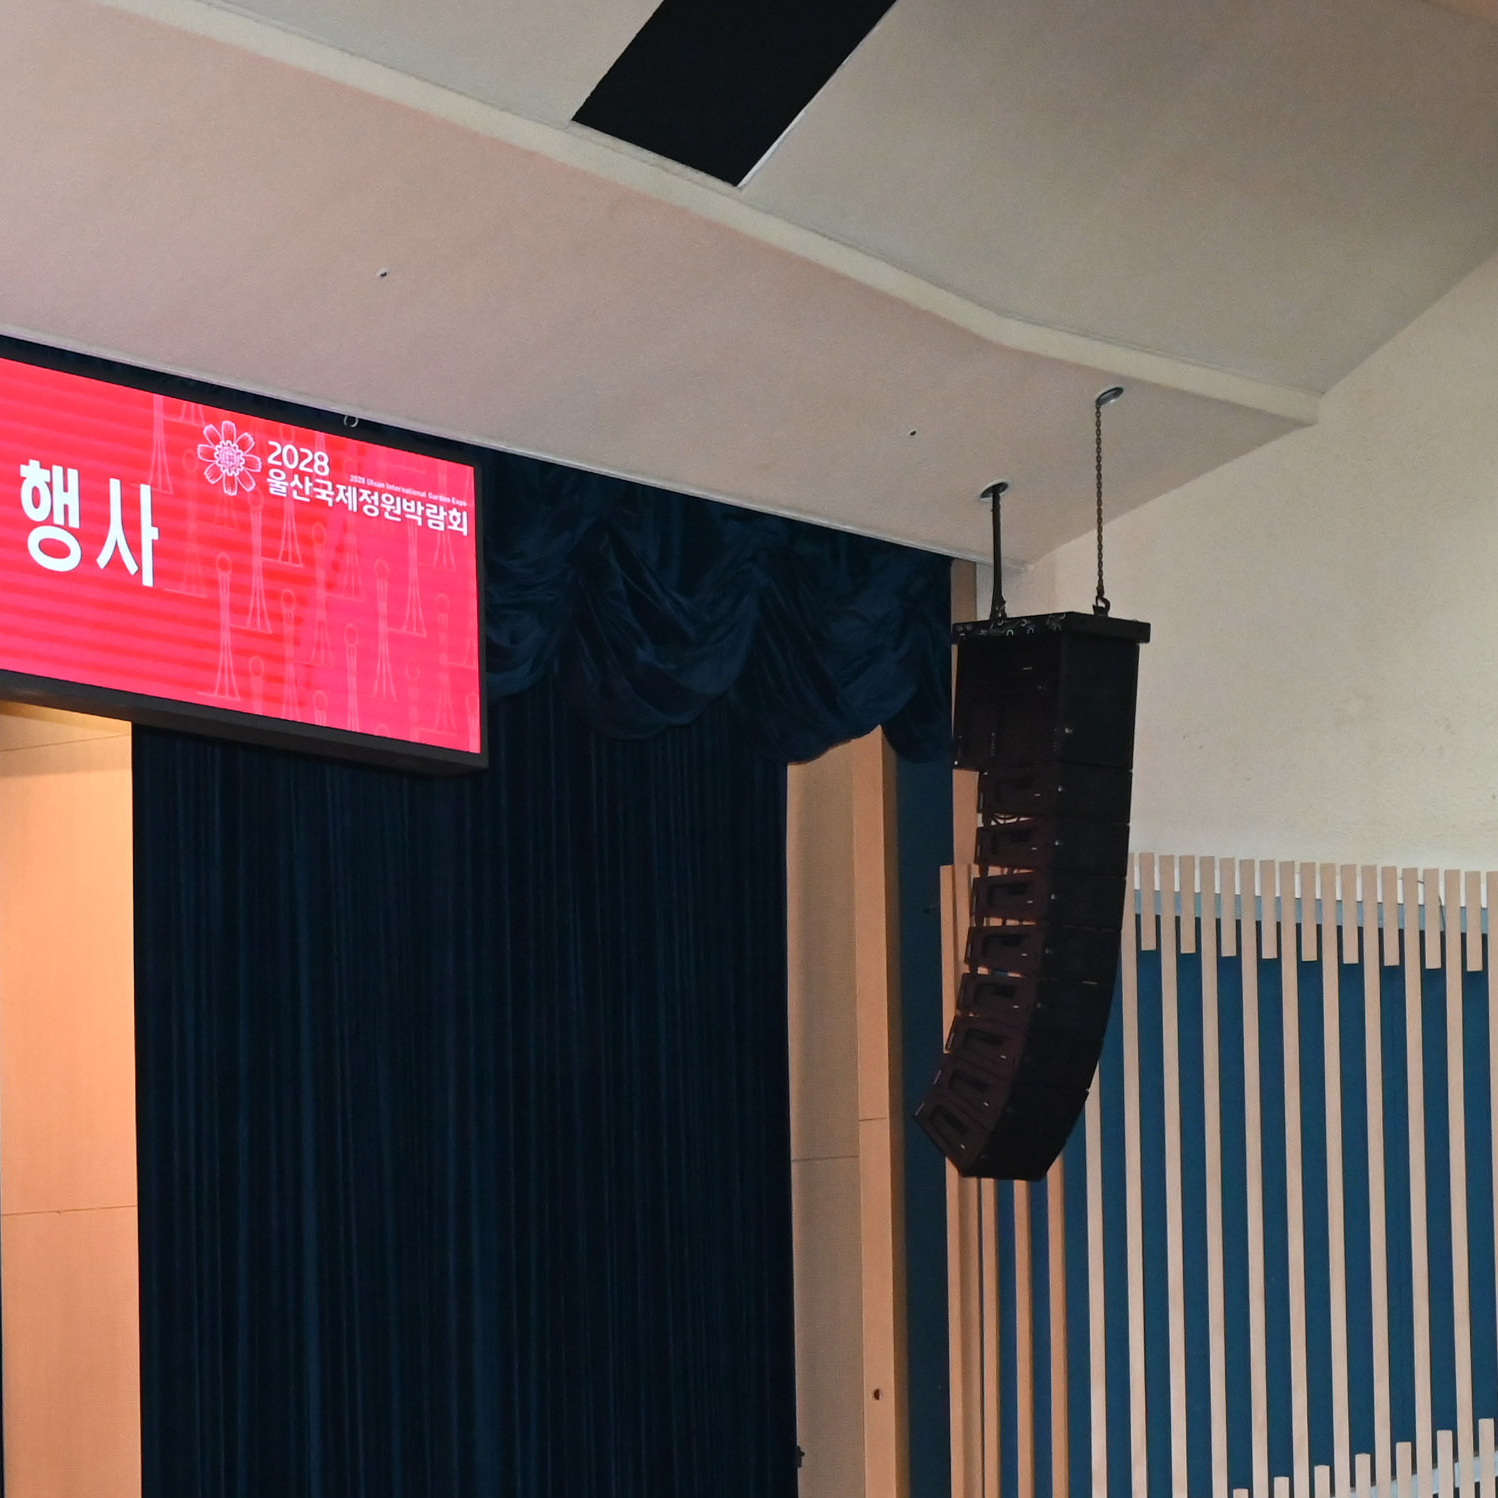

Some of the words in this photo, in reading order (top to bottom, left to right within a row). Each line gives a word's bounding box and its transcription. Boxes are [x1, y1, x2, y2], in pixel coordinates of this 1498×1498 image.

[267, 441, 329, 476] 2028
[267, 469, 468, 536] 울산국제정원박람회
[350, 475, 365, 484] 2028
[367, 478, 384, 488] Ulsan
[386, 482, 427, 497] International
[428, 493, 450, 503] Garden
[452, 497, 467, 507] Expo
[20, 459, 160, 588] 행사
